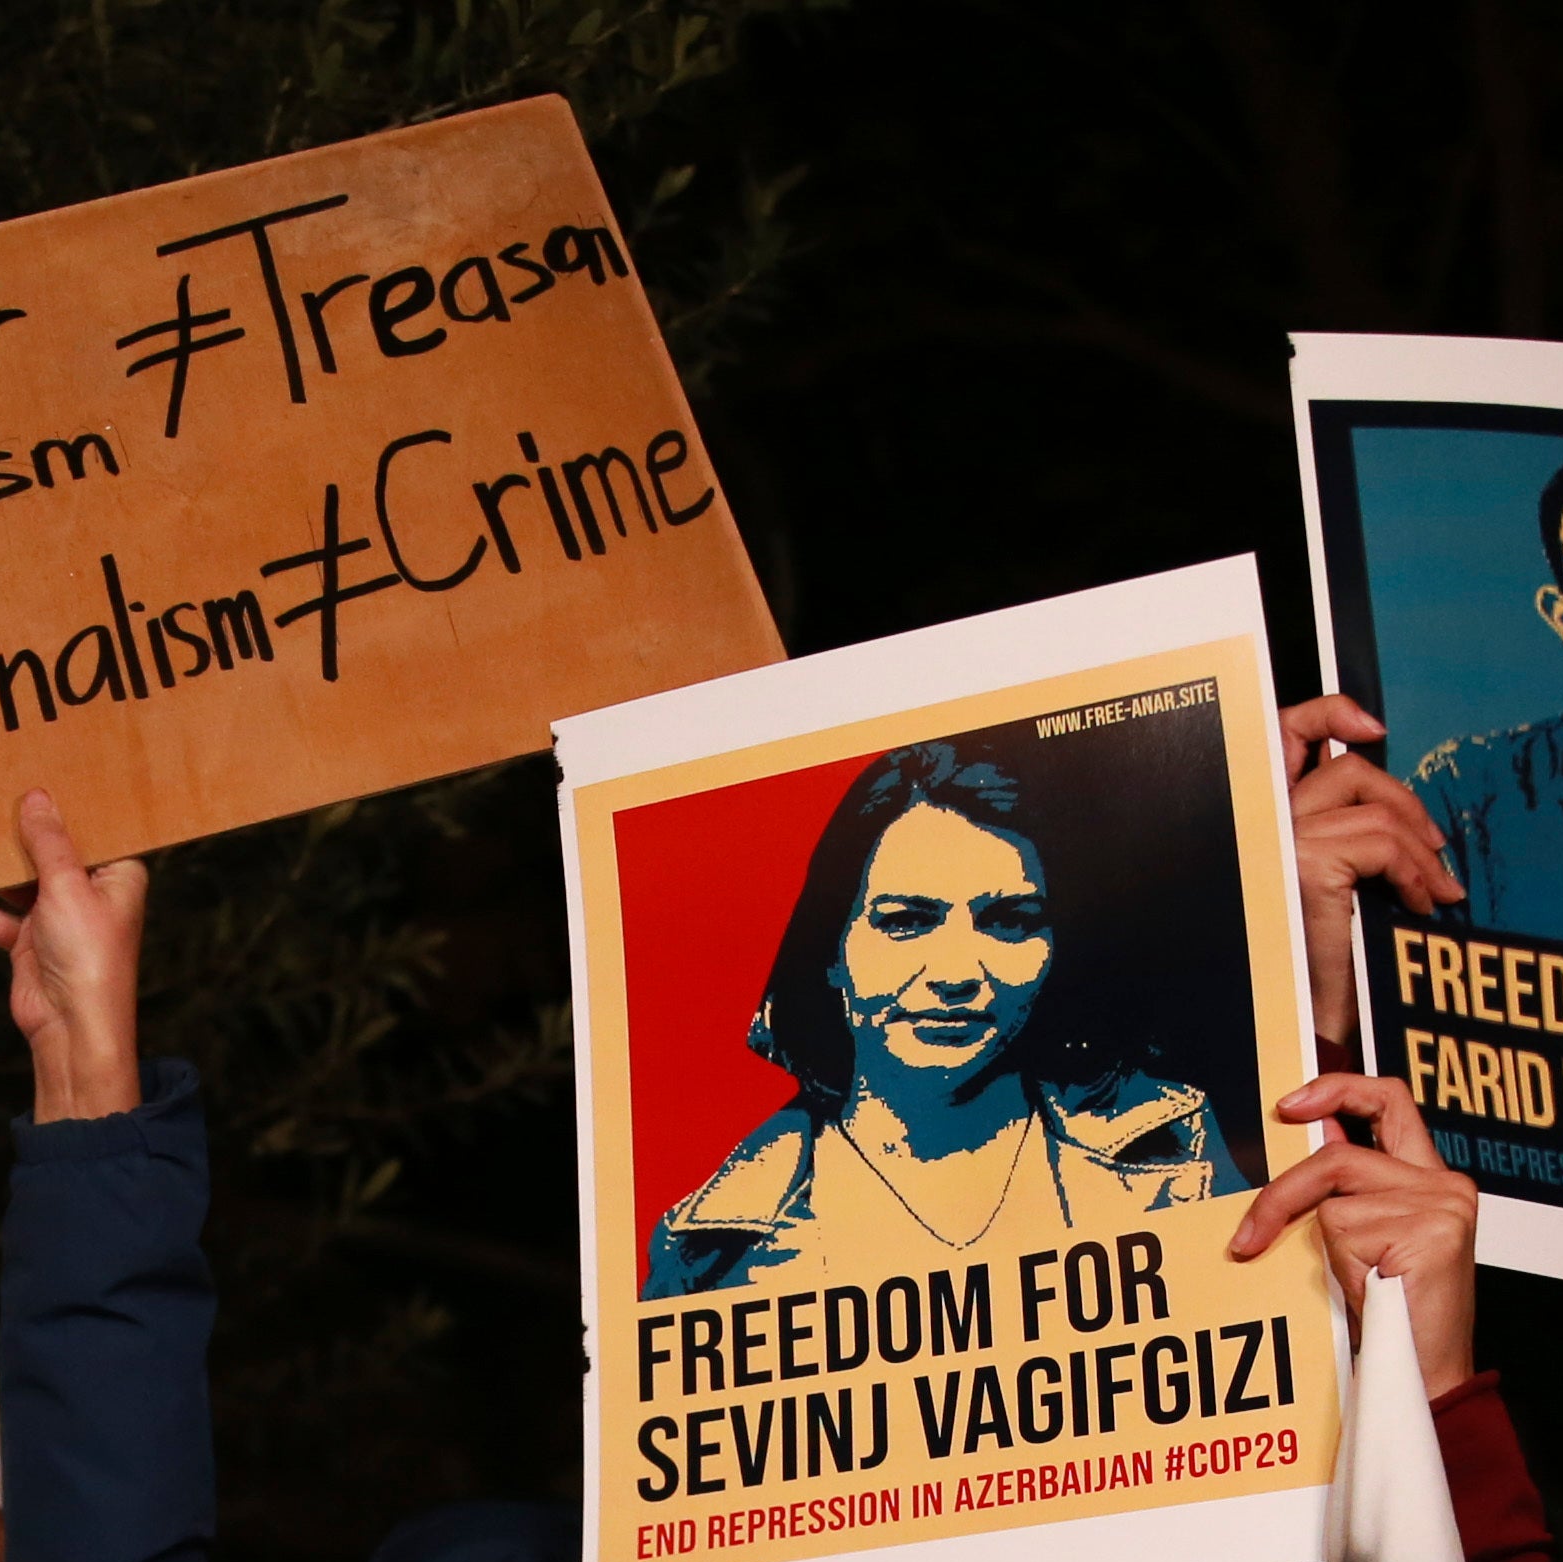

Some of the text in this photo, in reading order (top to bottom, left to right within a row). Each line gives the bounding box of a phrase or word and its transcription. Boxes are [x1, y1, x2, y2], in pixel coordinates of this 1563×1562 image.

[1035, 681, 1216, 739] WWW.FREE-ANAR.SITE
[1404, 1027, 1555, 1130] FARID
[1430, 1129, 1471, 1169] ND
[637, 1231, 1169, 1402] FREEDOM FOR
[637, 1315, 1296, 1503] SEVINJ VAGIFGIZI
[638, 1429, 1299, 1560] END REPRESSION IN AZERBAIJAN #COP29
